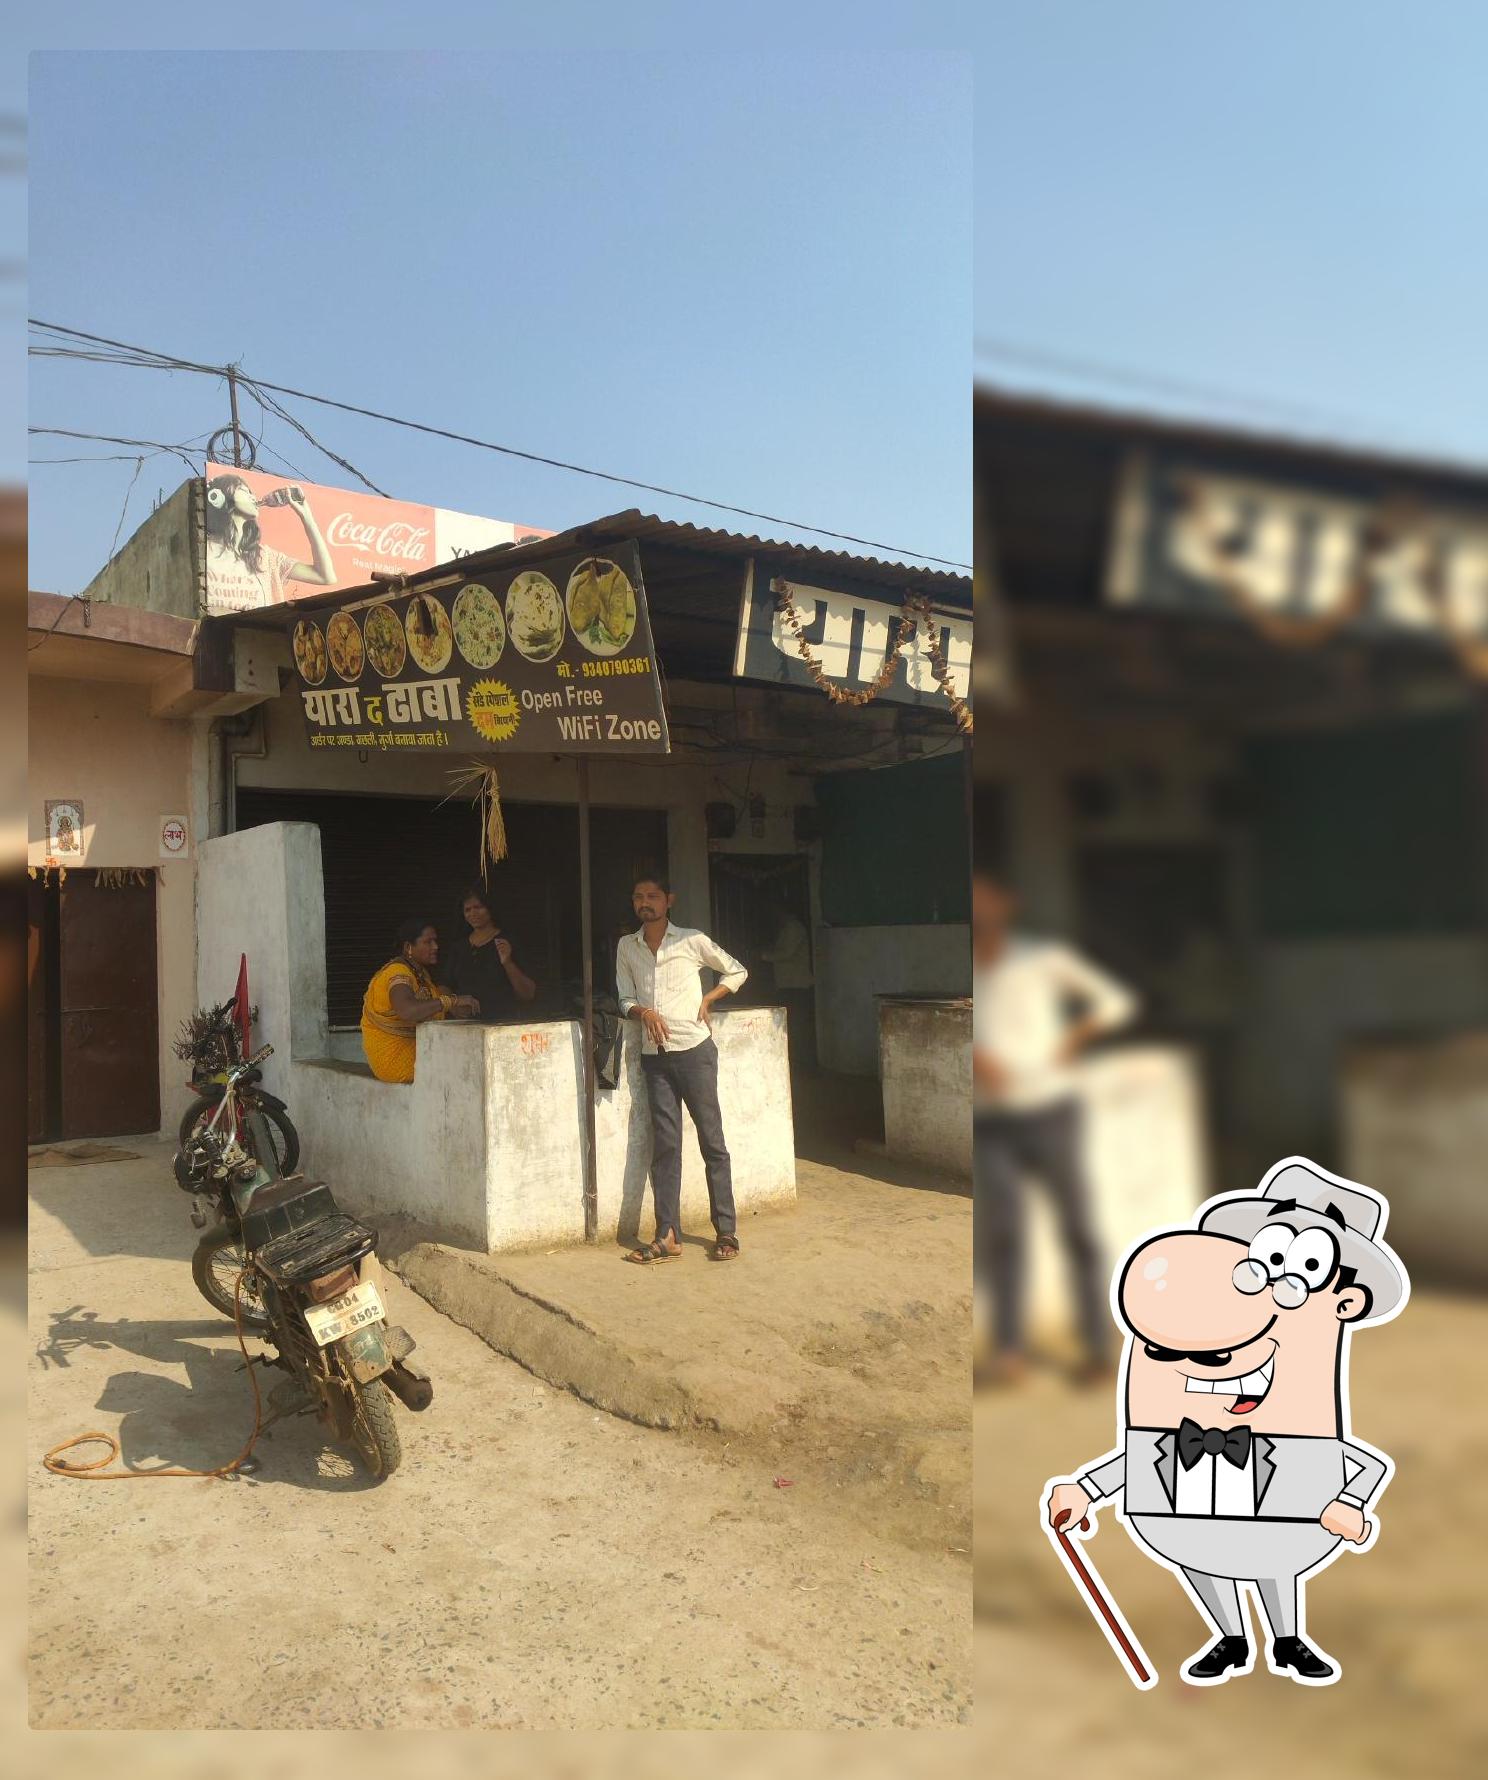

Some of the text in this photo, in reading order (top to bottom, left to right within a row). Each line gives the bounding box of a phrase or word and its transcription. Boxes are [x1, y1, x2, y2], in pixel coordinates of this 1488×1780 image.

[326, 512, 431, 561] Coca-Cola
[301, 677, 463, 726] यारा द ढाबा
[521, 686, 603, 713] Open Free
[557, 715, 662, 740] WiFi Zone
[349, 1305, 379, 1326] 8502
